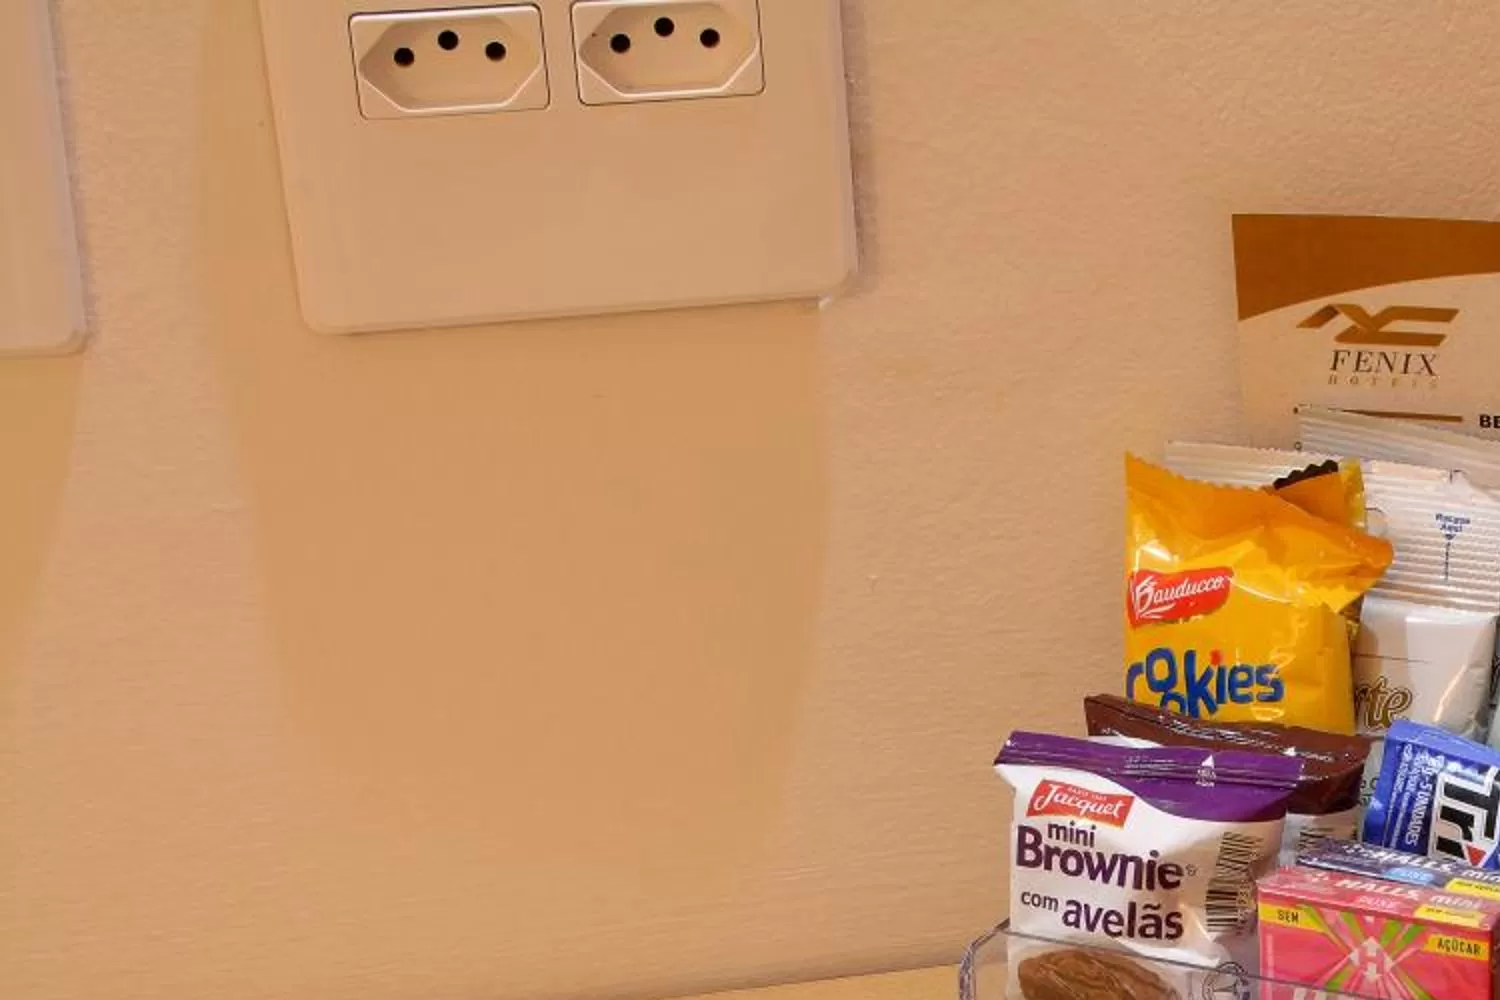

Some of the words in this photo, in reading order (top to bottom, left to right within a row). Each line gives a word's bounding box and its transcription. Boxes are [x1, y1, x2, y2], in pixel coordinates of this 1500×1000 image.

[1329, 349, 1440, 377] FENIX
[1134, 575, 1225, 618] Bauducco
[1033, 783, 1126, 822] Jacquet
[1047, 821, 1097, 847] mini
[1016, 825, 1184, 892] Brownie
[1335, 878, 1420, 900] HALLS
[1020, 888, 1059, 913] com
[1062, 898, 1185, 941] avelãs
[1276, 910, 1300, 924] SEM
